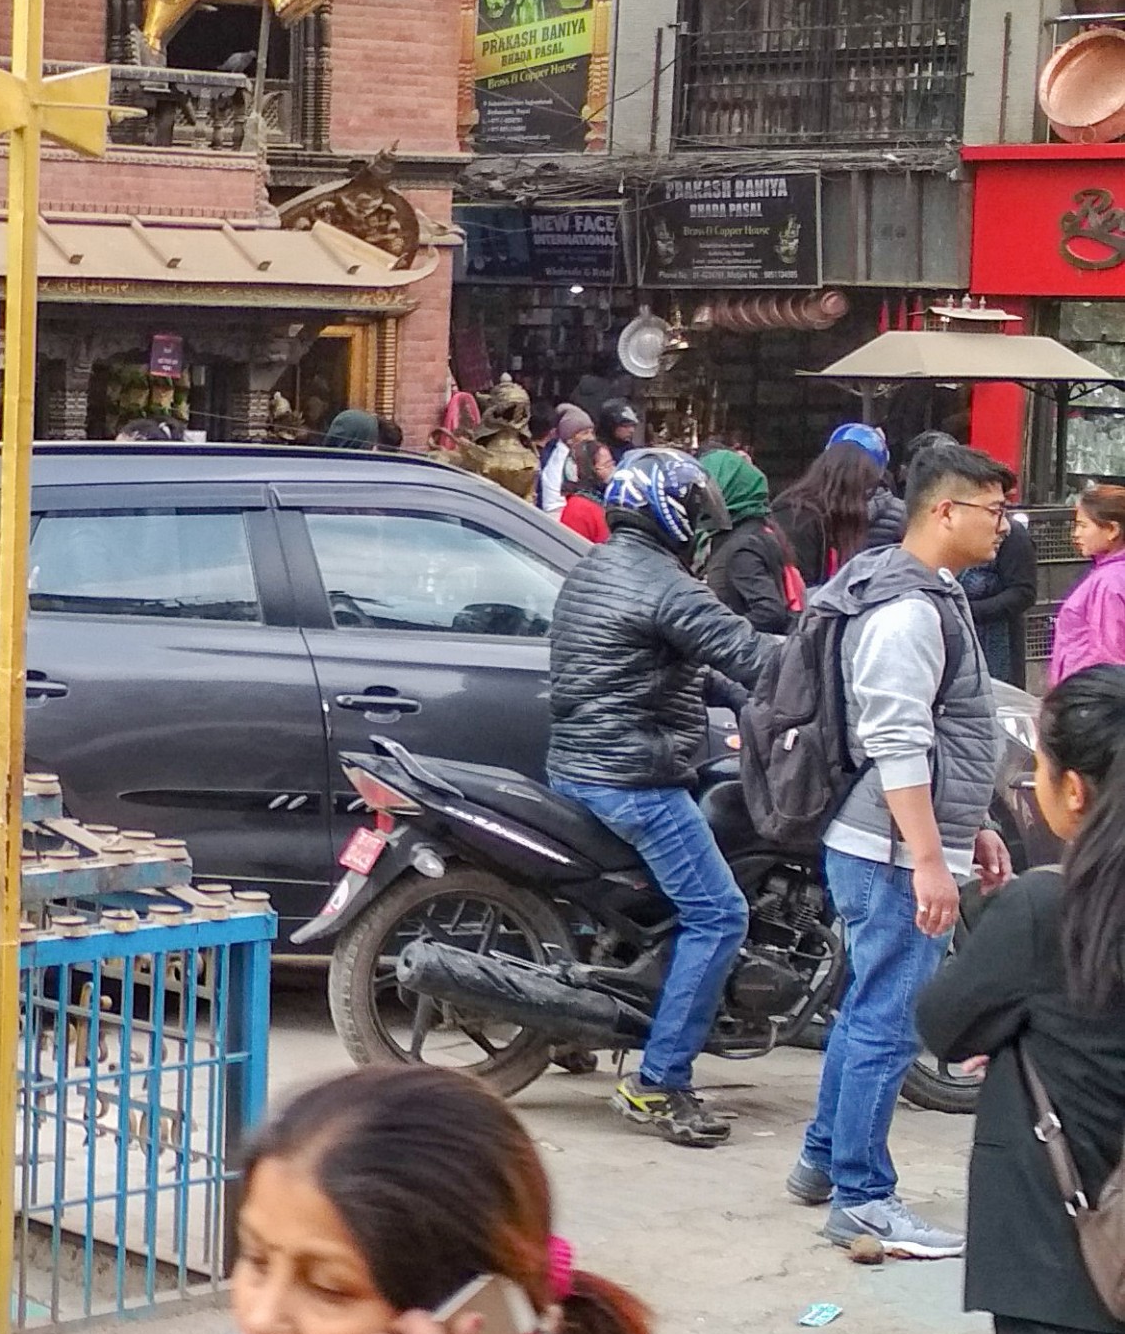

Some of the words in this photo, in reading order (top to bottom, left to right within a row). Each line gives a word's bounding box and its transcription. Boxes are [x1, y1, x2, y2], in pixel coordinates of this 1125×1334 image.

[481, 28, 538, 57] PRAKASH
[541, 18, 586, 42] BANIYA
[501, 52, 532, 67] BHADA
[535, 42, 564, 61] PASAL
[665, 179, 732, 200] PRAKASH
[735, 178, 788, 199] BANIYA
[689, 203, 726, 218] BHADA
[728, 202, 763, 218] PASAL
[531, 215, 570, 232] NEW
[576, 216, 616, 233] FACE
[714, 225, 743, 237] Copper
[744, 224, 770, 235] House
[533, 234, 619, 246] INTERNATIONAL
